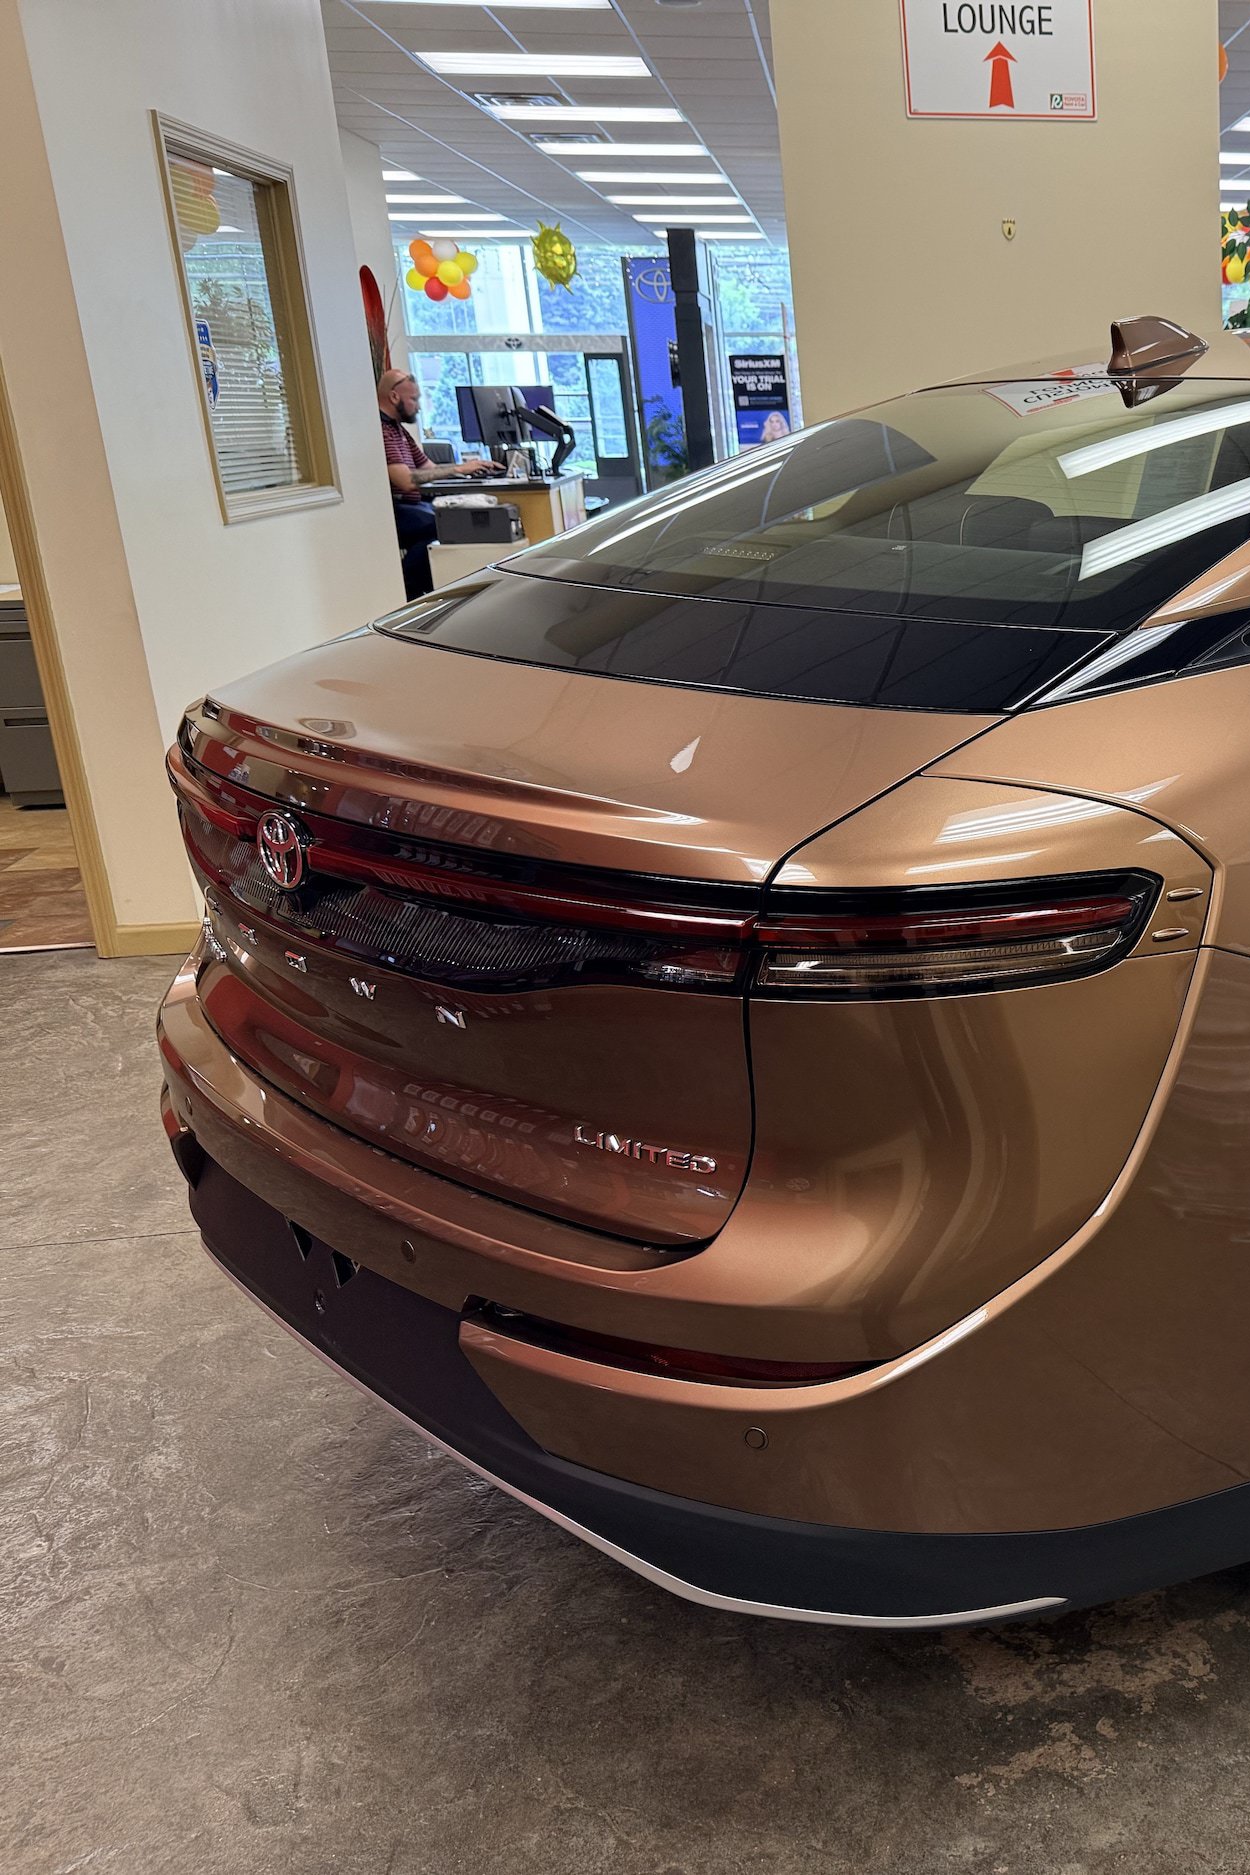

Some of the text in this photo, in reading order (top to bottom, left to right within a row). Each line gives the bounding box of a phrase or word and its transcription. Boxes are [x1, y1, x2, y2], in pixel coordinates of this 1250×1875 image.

[943, 3, 1053, 36] LOUNGE
[734, 359, 780, 369] SiriusXM
[732, 375, 785, 384] YOUR TRIAL
[746, 383, 772, 391] IS ON
[574, 1125, 718, 1174] LIMITED
